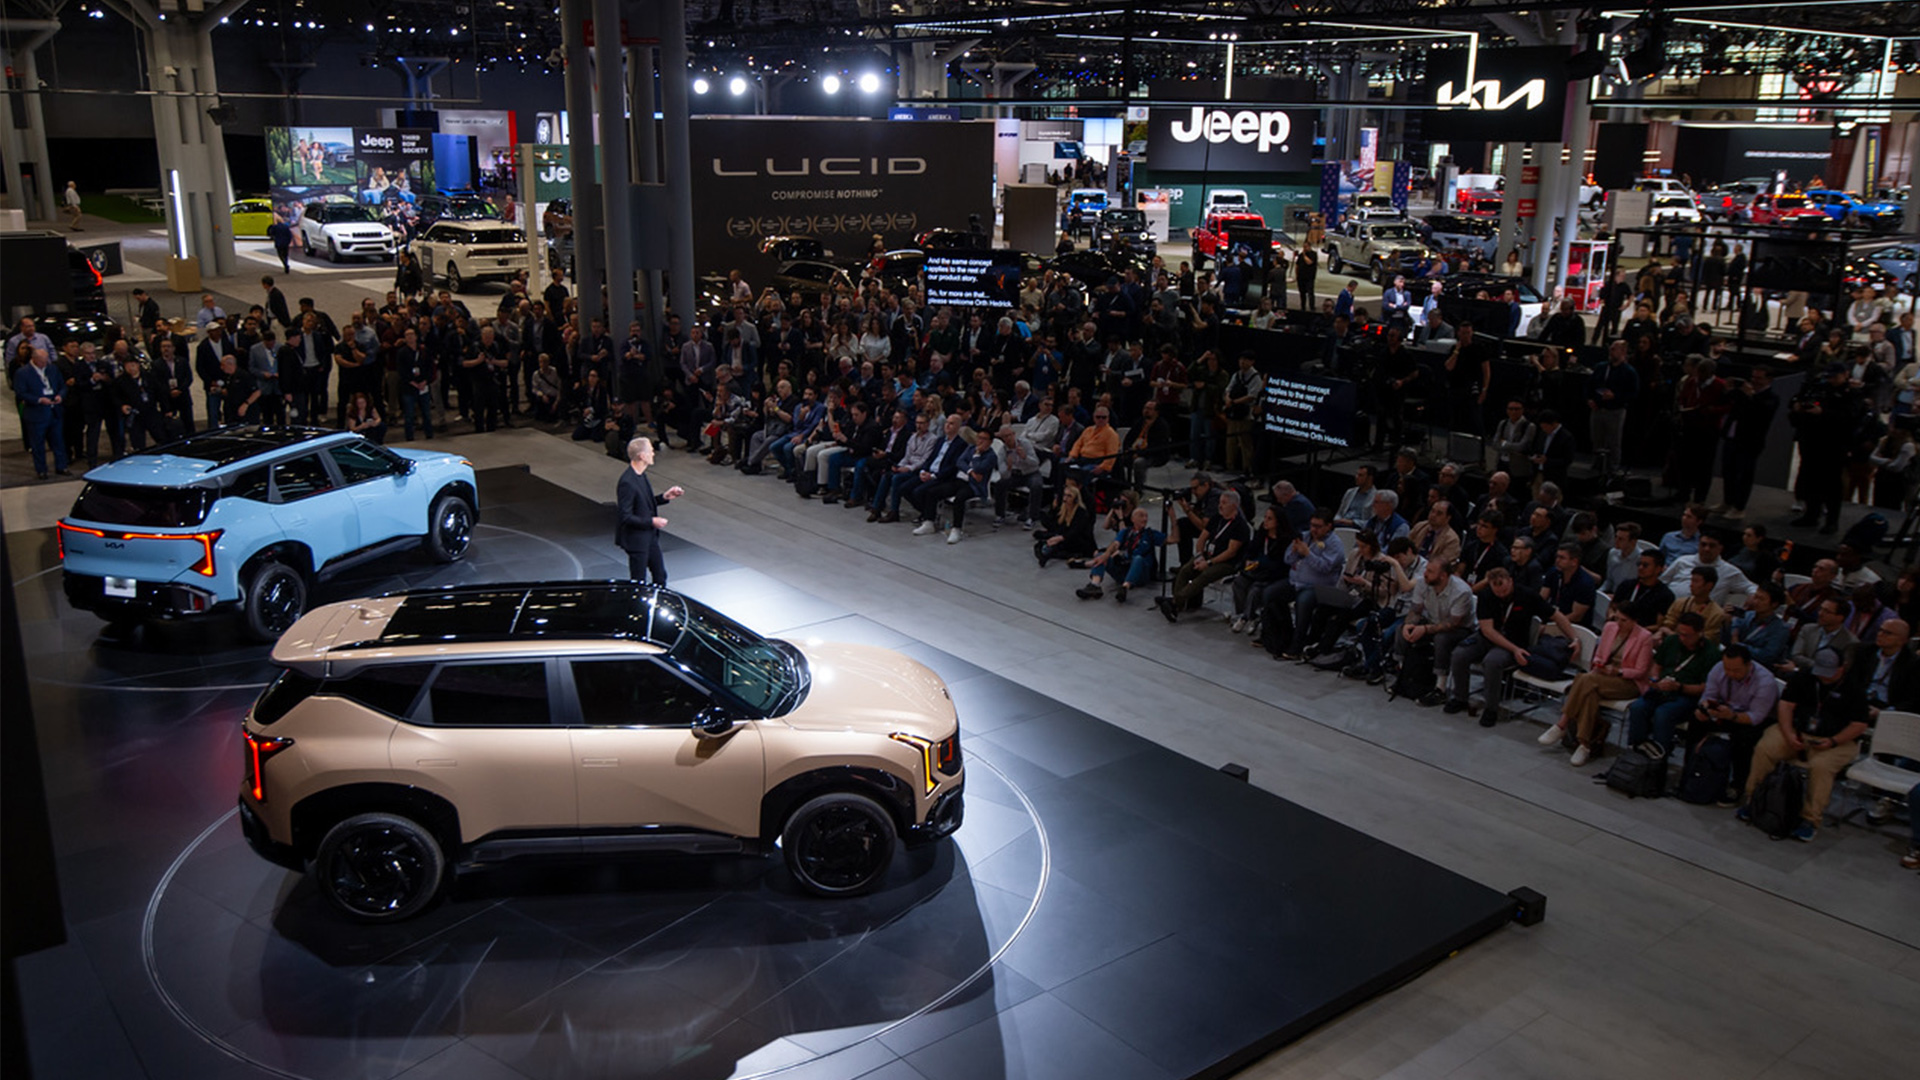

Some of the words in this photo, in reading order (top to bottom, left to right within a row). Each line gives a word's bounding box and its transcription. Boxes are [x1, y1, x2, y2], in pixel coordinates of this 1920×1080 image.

[360, 134, 394, 149] Jeep
[540, 161, 571, 183] Je
[713, 158, 927, 176] LUCID
[772, 190, 835, 200] COMPROMISE
[962, 275, 978, 283] story.
[1268, 377, 1280, 386] And
[1281, 379, 1289, 387] the
[1291, 382, 1306, 390] same
[1307, 385, 1331, 395] concept
[1268, 388, 1287, 396] applies
[1277, 398, 1298, 408] product
[1299, 402, 1315, 412] story.
[1266, 413, 1276, 422] So,
[1276, 415, 1284, 423] for
[1285, 419, 1300, 427] more
[1309, 422, 1326, 433] that...
[1265, 423, 1284, 432] please
[1285, 428, 1309, 438] welcome
[1310, 432, 1323, 440] Orth
